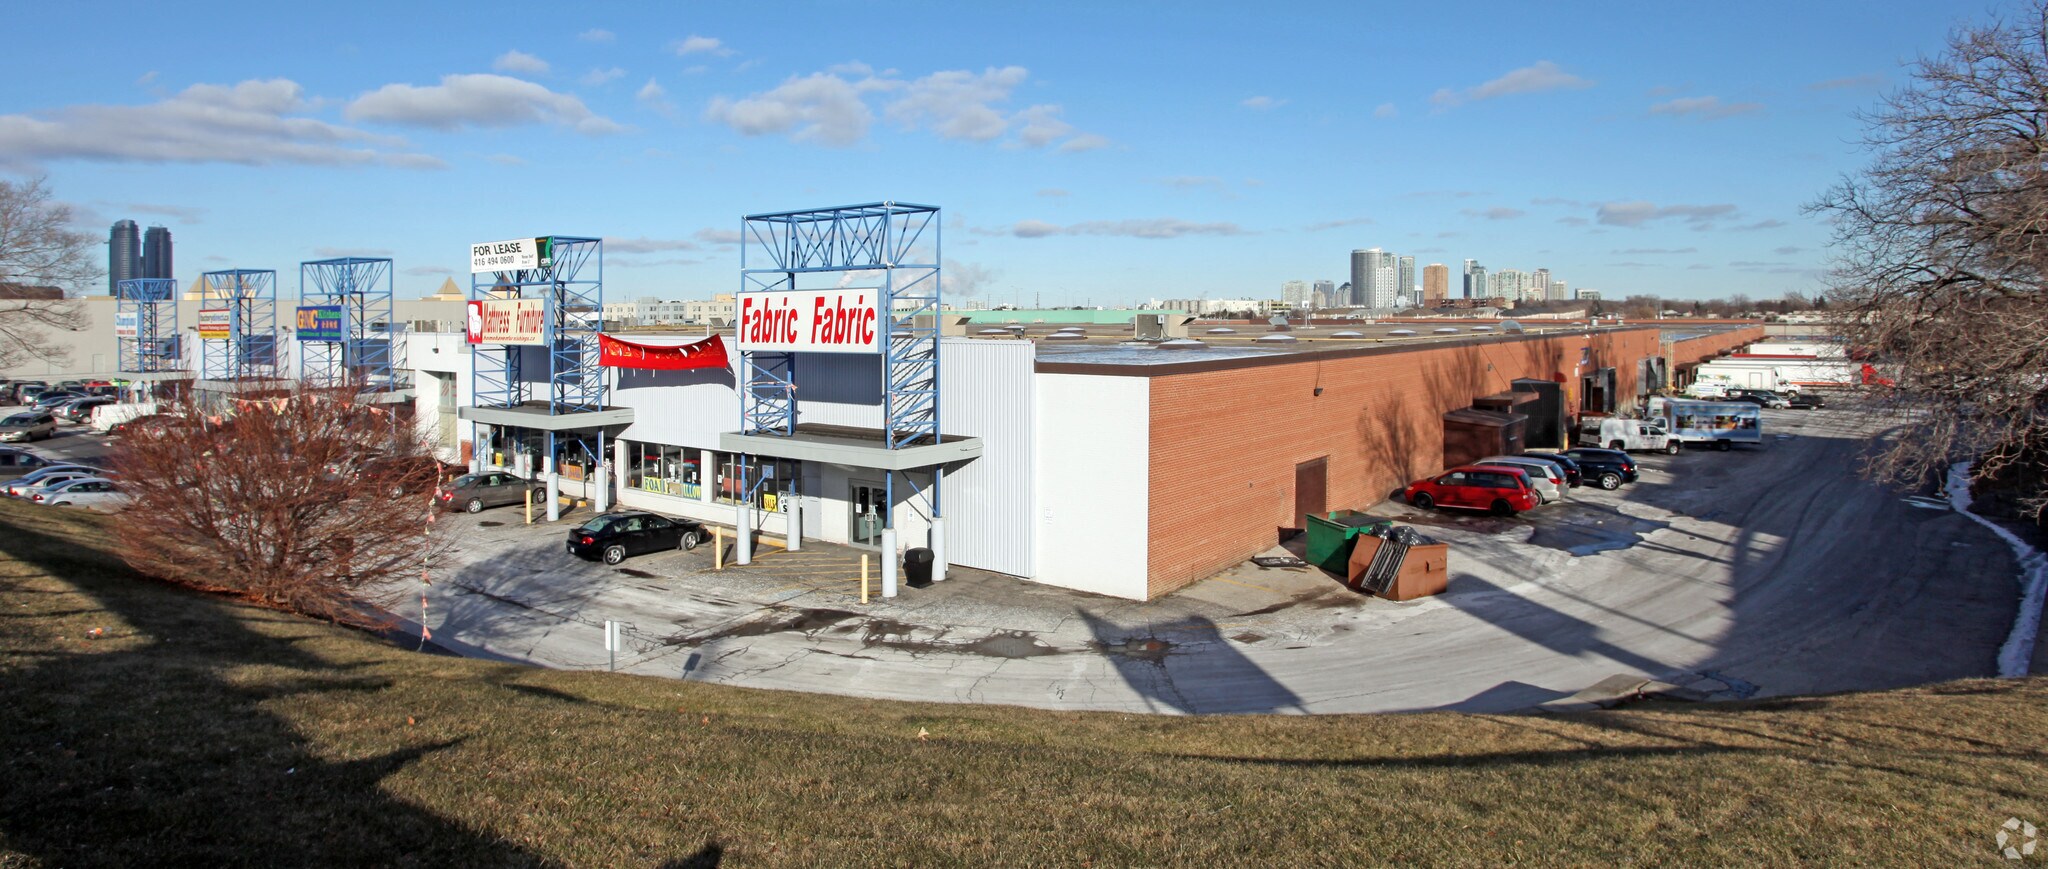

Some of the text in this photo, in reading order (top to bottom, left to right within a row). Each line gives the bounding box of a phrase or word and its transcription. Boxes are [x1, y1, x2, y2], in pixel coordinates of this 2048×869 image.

[473, 242, 522, 257] FOR LEASE
[474, 258, 486, 266] 416
[487, 256, 499, 265] 494
[500, 255, 514, 265] 0600
[297, 309, 319, 329] GNC
[483, 301, 545, 334] Mattress Furniture
[740, 294, 875, 345] Fabric Fabric
